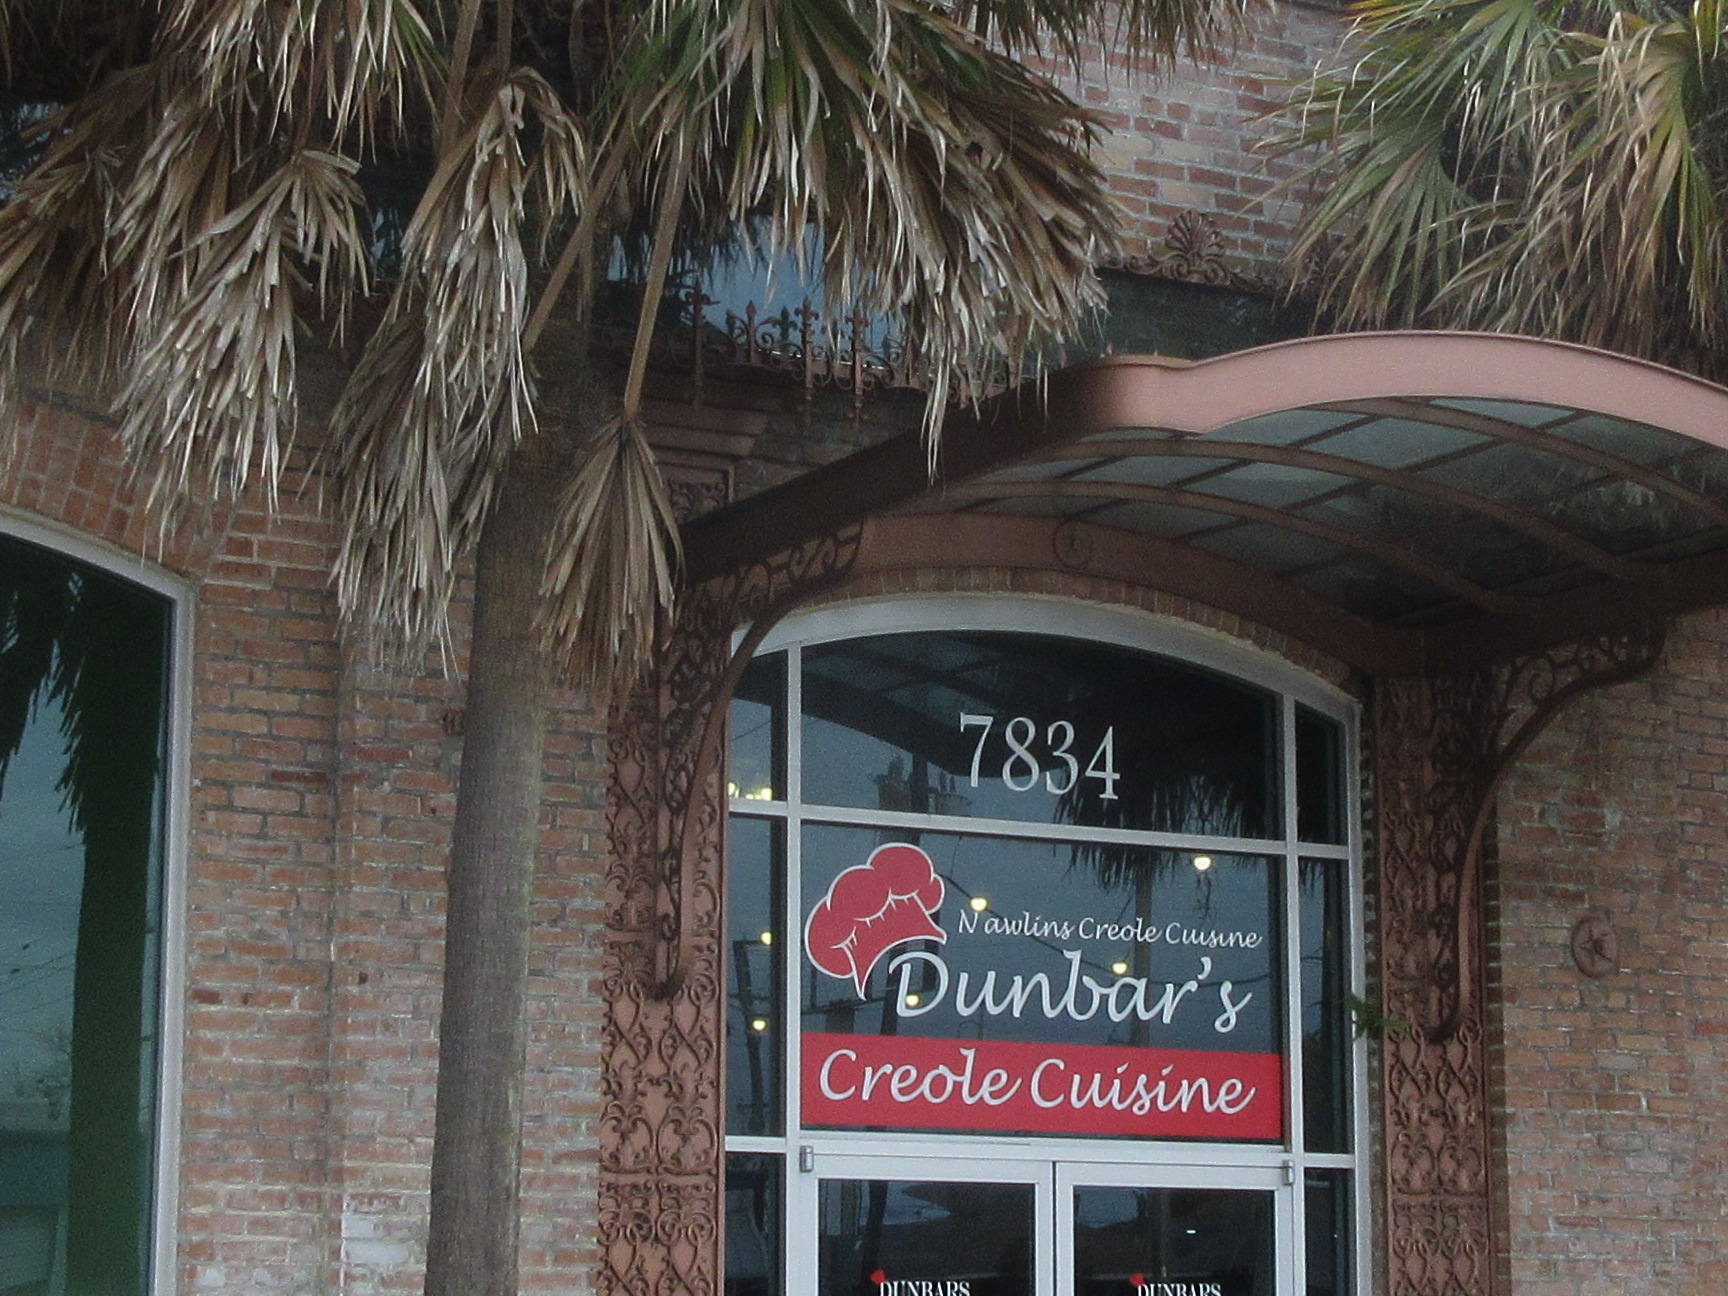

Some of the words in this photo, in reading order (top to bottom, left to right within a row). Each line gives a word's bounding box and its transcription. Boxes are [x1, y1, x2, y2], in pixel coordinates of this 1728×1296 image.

[960, 712, 1121, 799] 7834
[1079, 916, 1162, 943] Creole
[1165, 922, 1264, 950] Cuisine
[888, 949, 1253, 1034] Dunbar's
[819, 1047, 1022, 1106] Creole
[1030, 1057, 1257, 1116] Cuisine
